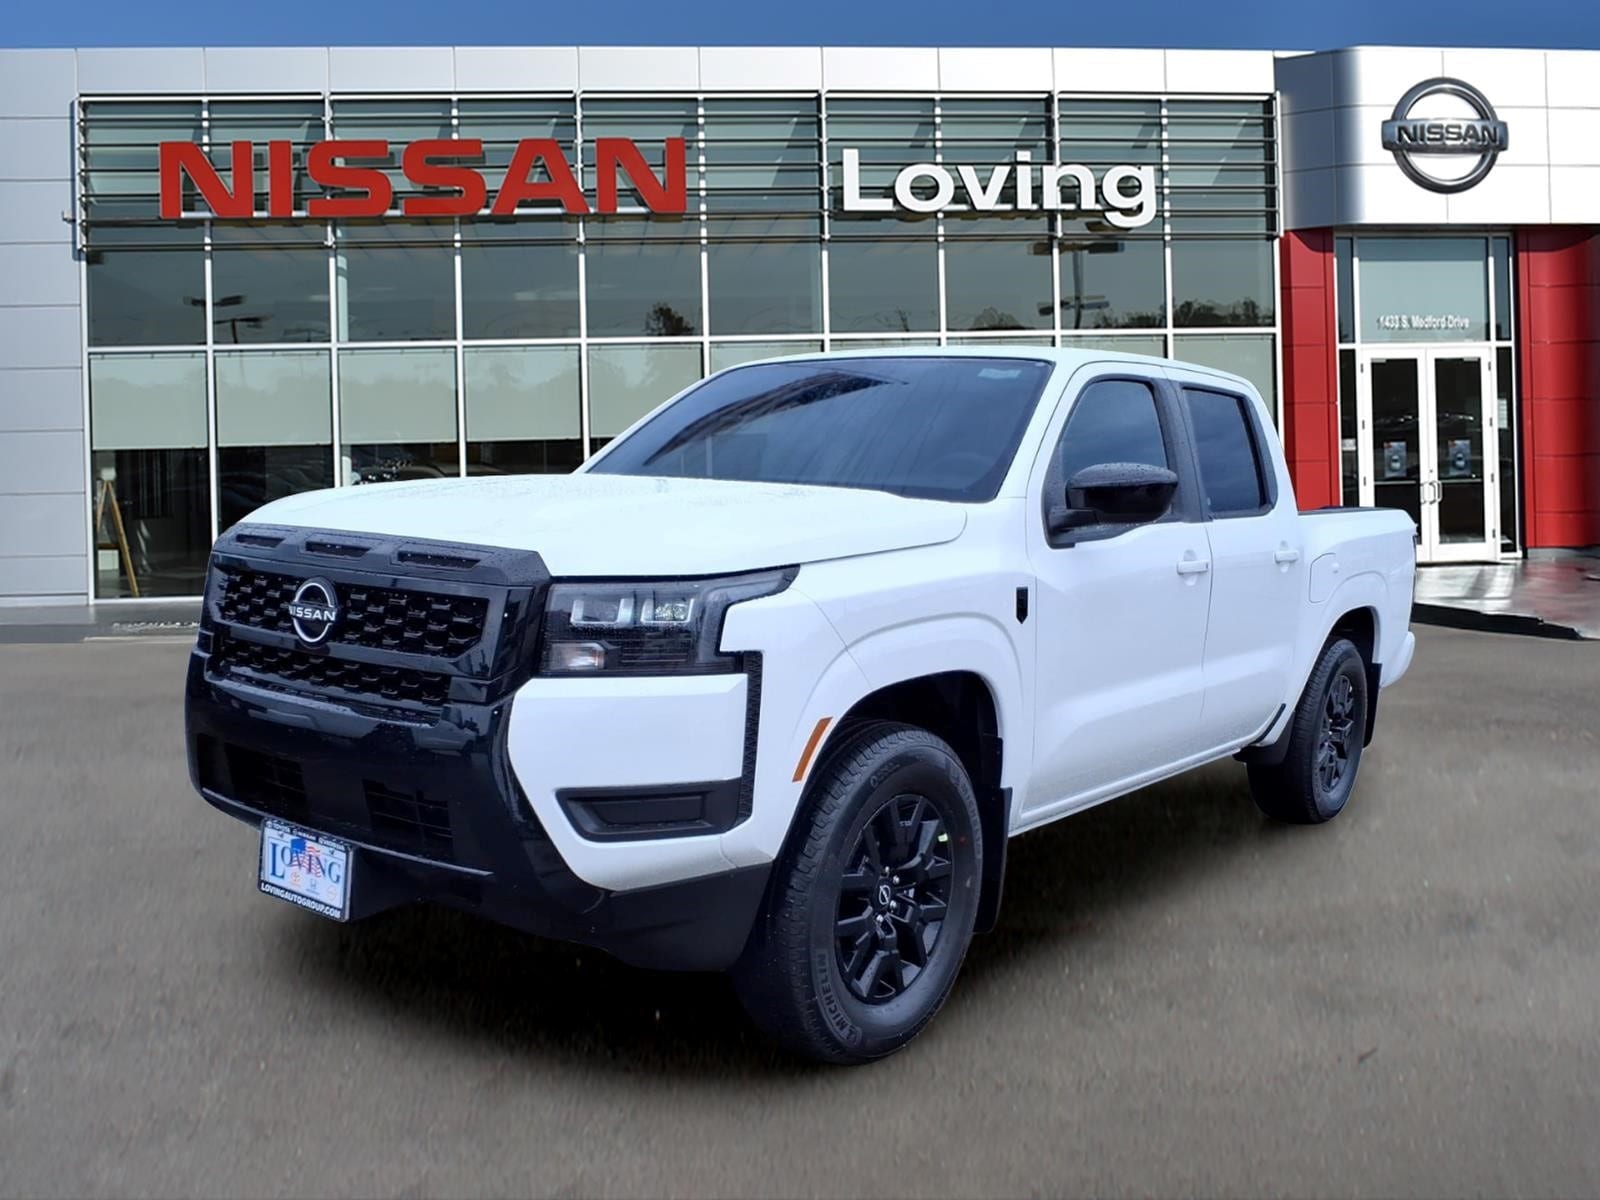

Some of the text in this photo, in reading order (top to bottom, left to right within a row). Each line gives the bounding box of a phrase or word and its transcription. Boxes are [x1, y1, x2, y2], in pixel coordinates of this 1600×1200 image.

[1397, 123, 1497, 143] NISSAN
[159, 138, 686, 218] NISSAN
[842, 148, 1157, 229] Loving
[1447, 314, 1470, 329] Drive
[288, 605, 336, 621] NISSAN
[816, 952, 850, 1032] MICHELIN
